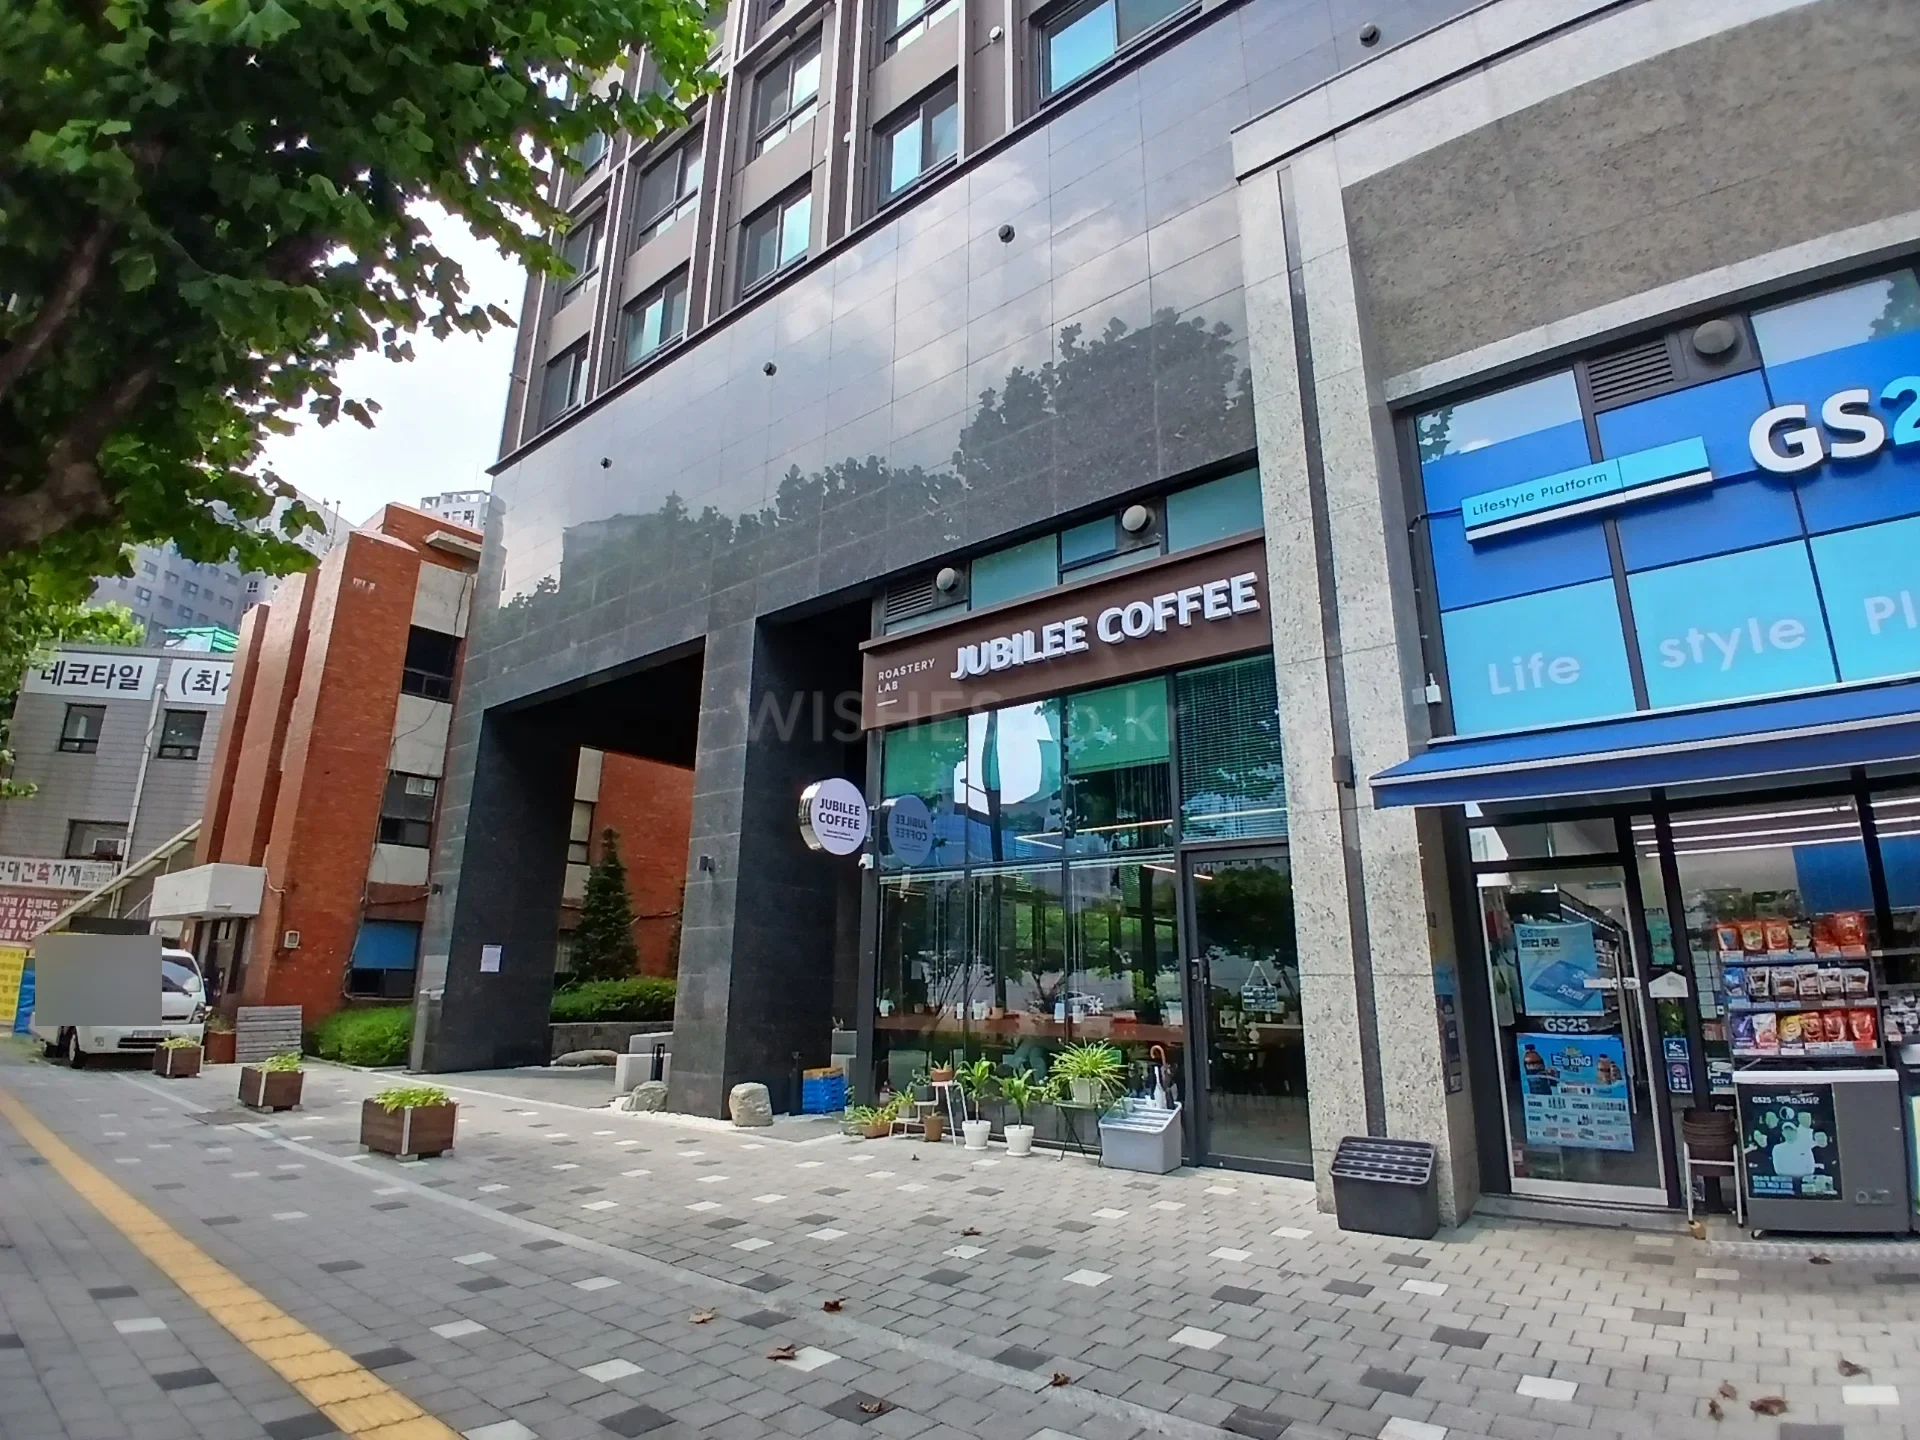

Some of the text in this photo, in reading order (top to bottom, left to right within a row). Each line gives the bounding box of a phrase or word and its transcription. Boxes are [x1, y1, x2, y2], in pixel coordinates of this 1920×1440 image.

[1473, 473, 1608, 516] Lifestyle Platform
[950, 572, 1260, 680] JUBILEE COFFEE
[1659, 617, 1806, 671] style
[878, 658, 936, 681] ROASTERY
[1488, 652, 1580, 695] Life
[877, 680, 899, 694] LAB
[819, 798, 860, 817] JUBILEE
[818, 812, 860, 831] COFFEE
[1544, 1018, 1590, 1033] GS25
